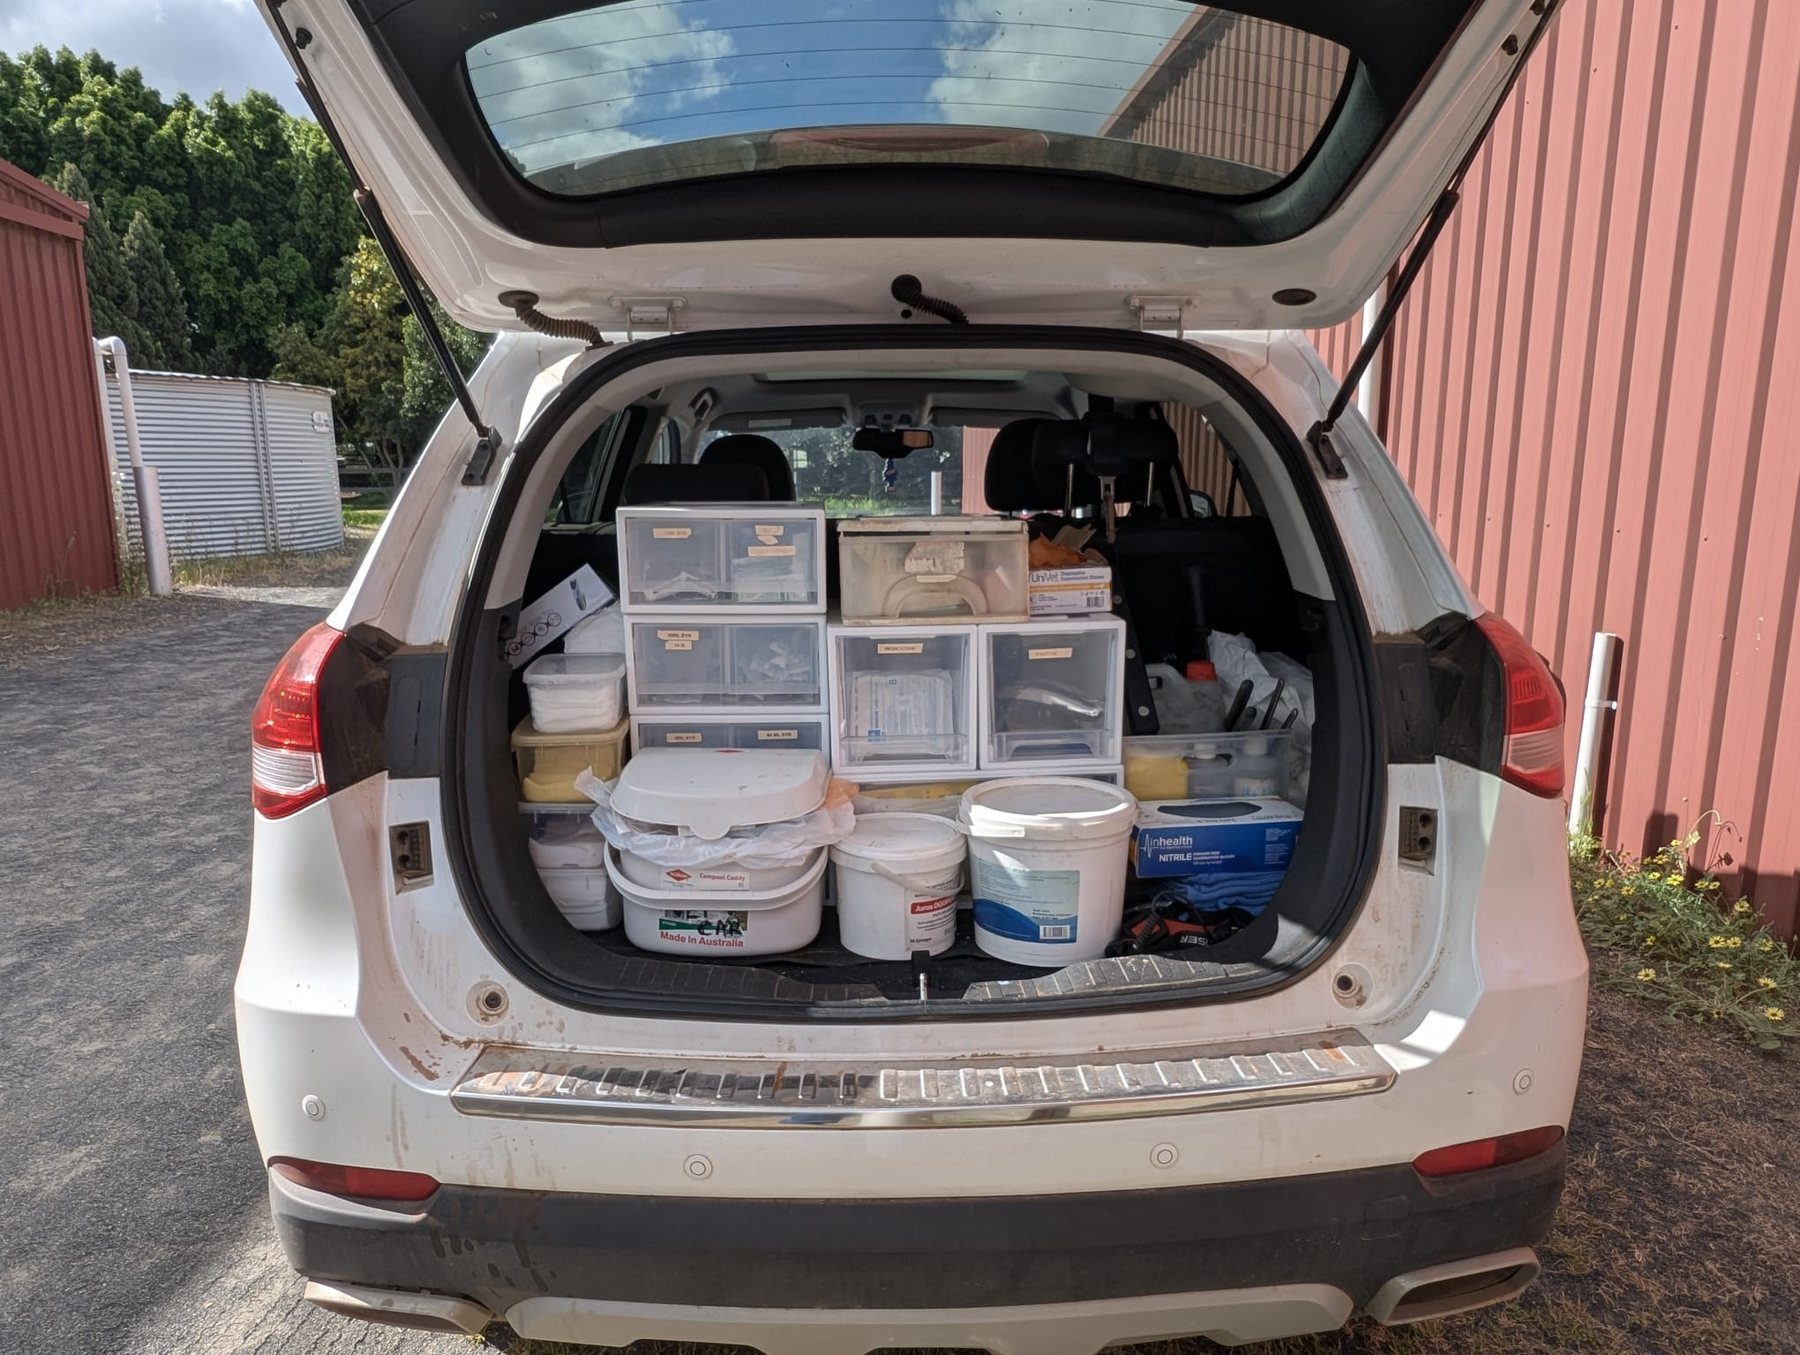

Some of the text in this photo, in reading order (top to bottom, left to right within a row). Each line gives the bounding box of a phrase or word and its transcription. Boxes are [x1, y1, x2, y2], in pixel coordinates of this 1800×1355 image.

[1031, 571, 1058, 582] UniVet
[1150, 835, 1193, 847] inhealth
[1158, 852, 1193, 863] NITRILE
[699, 872, 746, 882] Compost Caddy
[914, 904, 934, 912] Jurox
[660, 931, 745, 947] Made in Australia
